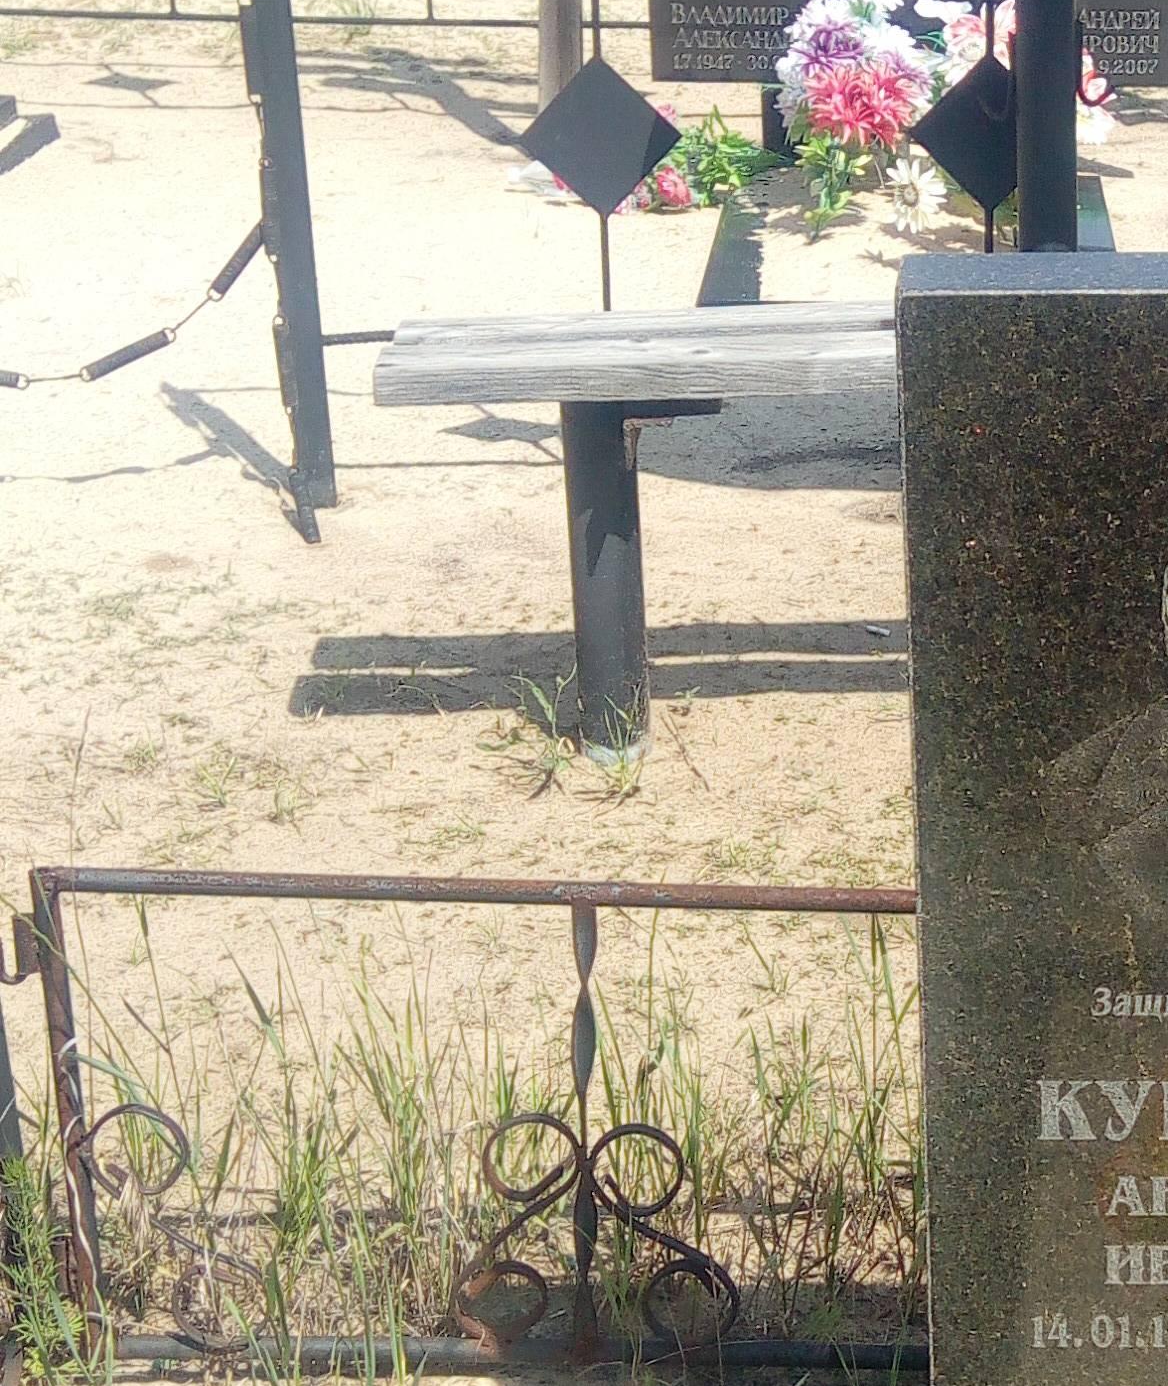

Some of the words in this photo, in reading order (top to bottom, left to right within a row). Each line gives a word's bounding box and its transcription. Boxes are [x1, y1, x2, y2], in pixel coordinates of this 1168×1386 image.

[670, 2, 789, 27] ВЛАДИМИР
[1079, 7, 1160, 33] АНДРЕЙ
[672, 27, 788, 52] АЛЕКСАНД
